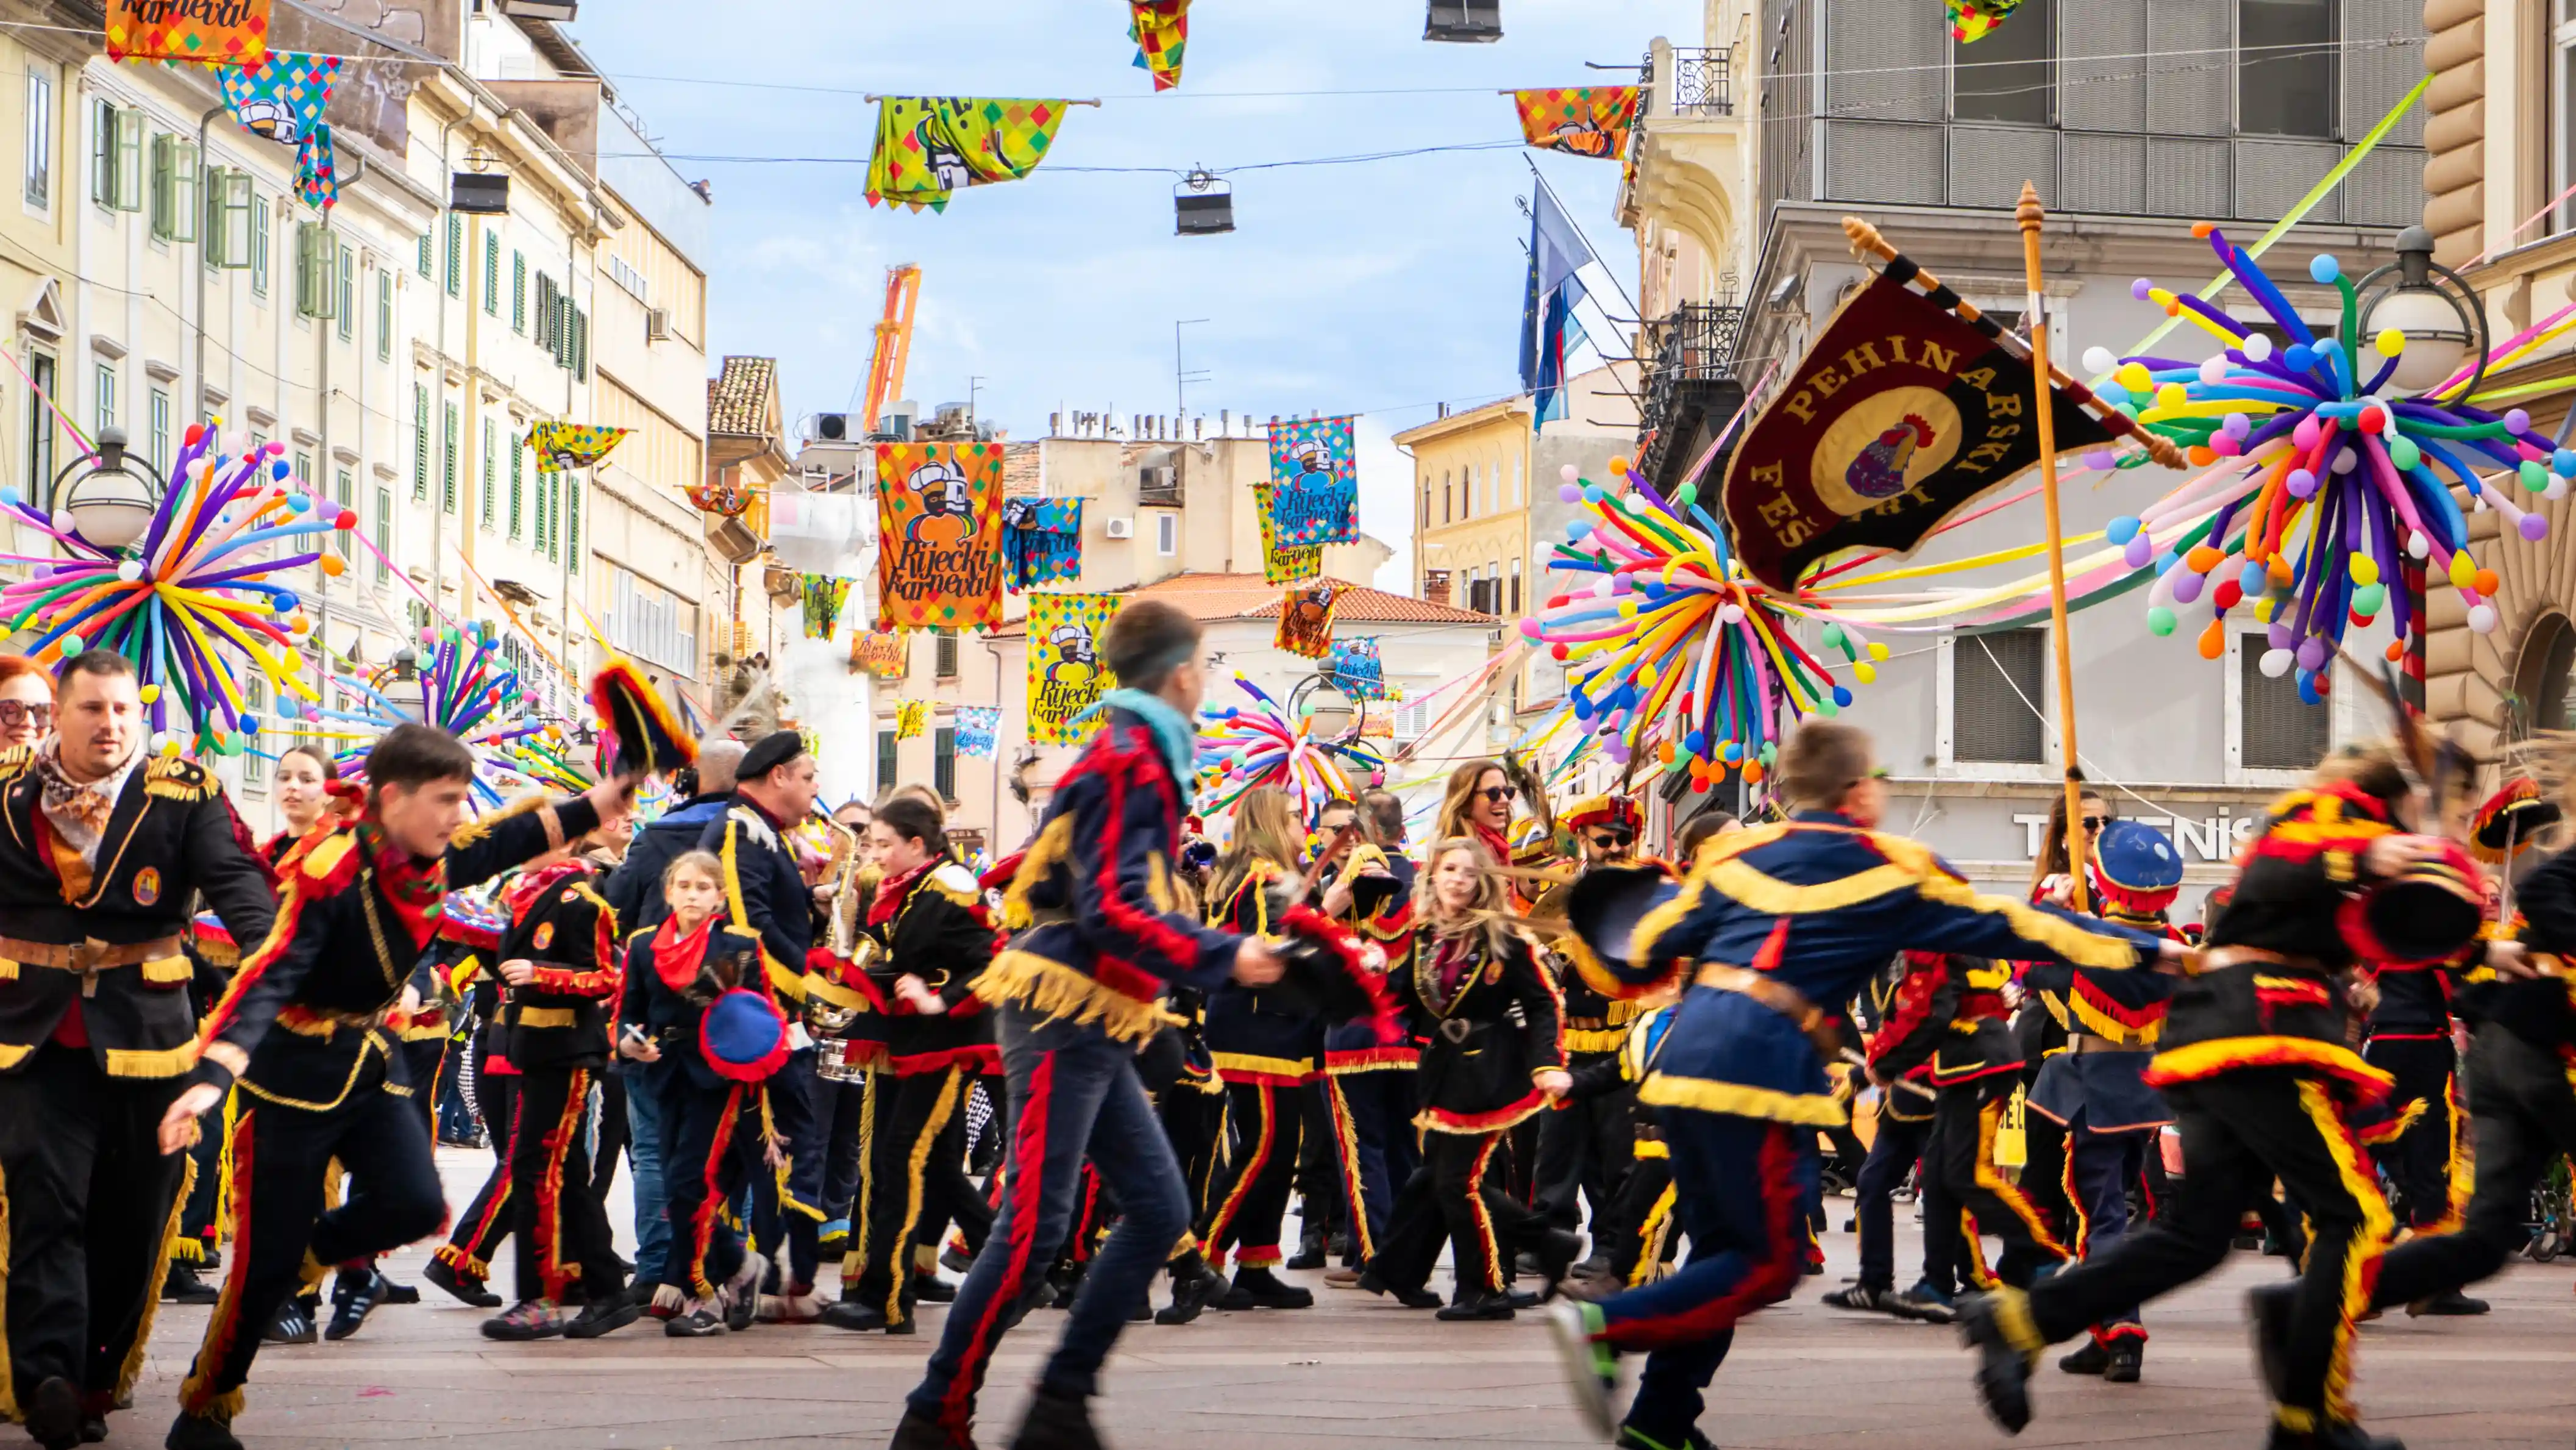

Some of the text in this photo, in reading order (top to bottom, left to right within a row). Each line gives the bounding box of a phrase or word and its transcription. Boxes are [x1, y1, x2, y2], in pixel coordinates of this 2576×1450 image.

[1782, 335, 2023, 473] PEHINARSKI
[888, 563, 994, 601] karneval
[1039, 679, 1106, 709] Riječk
